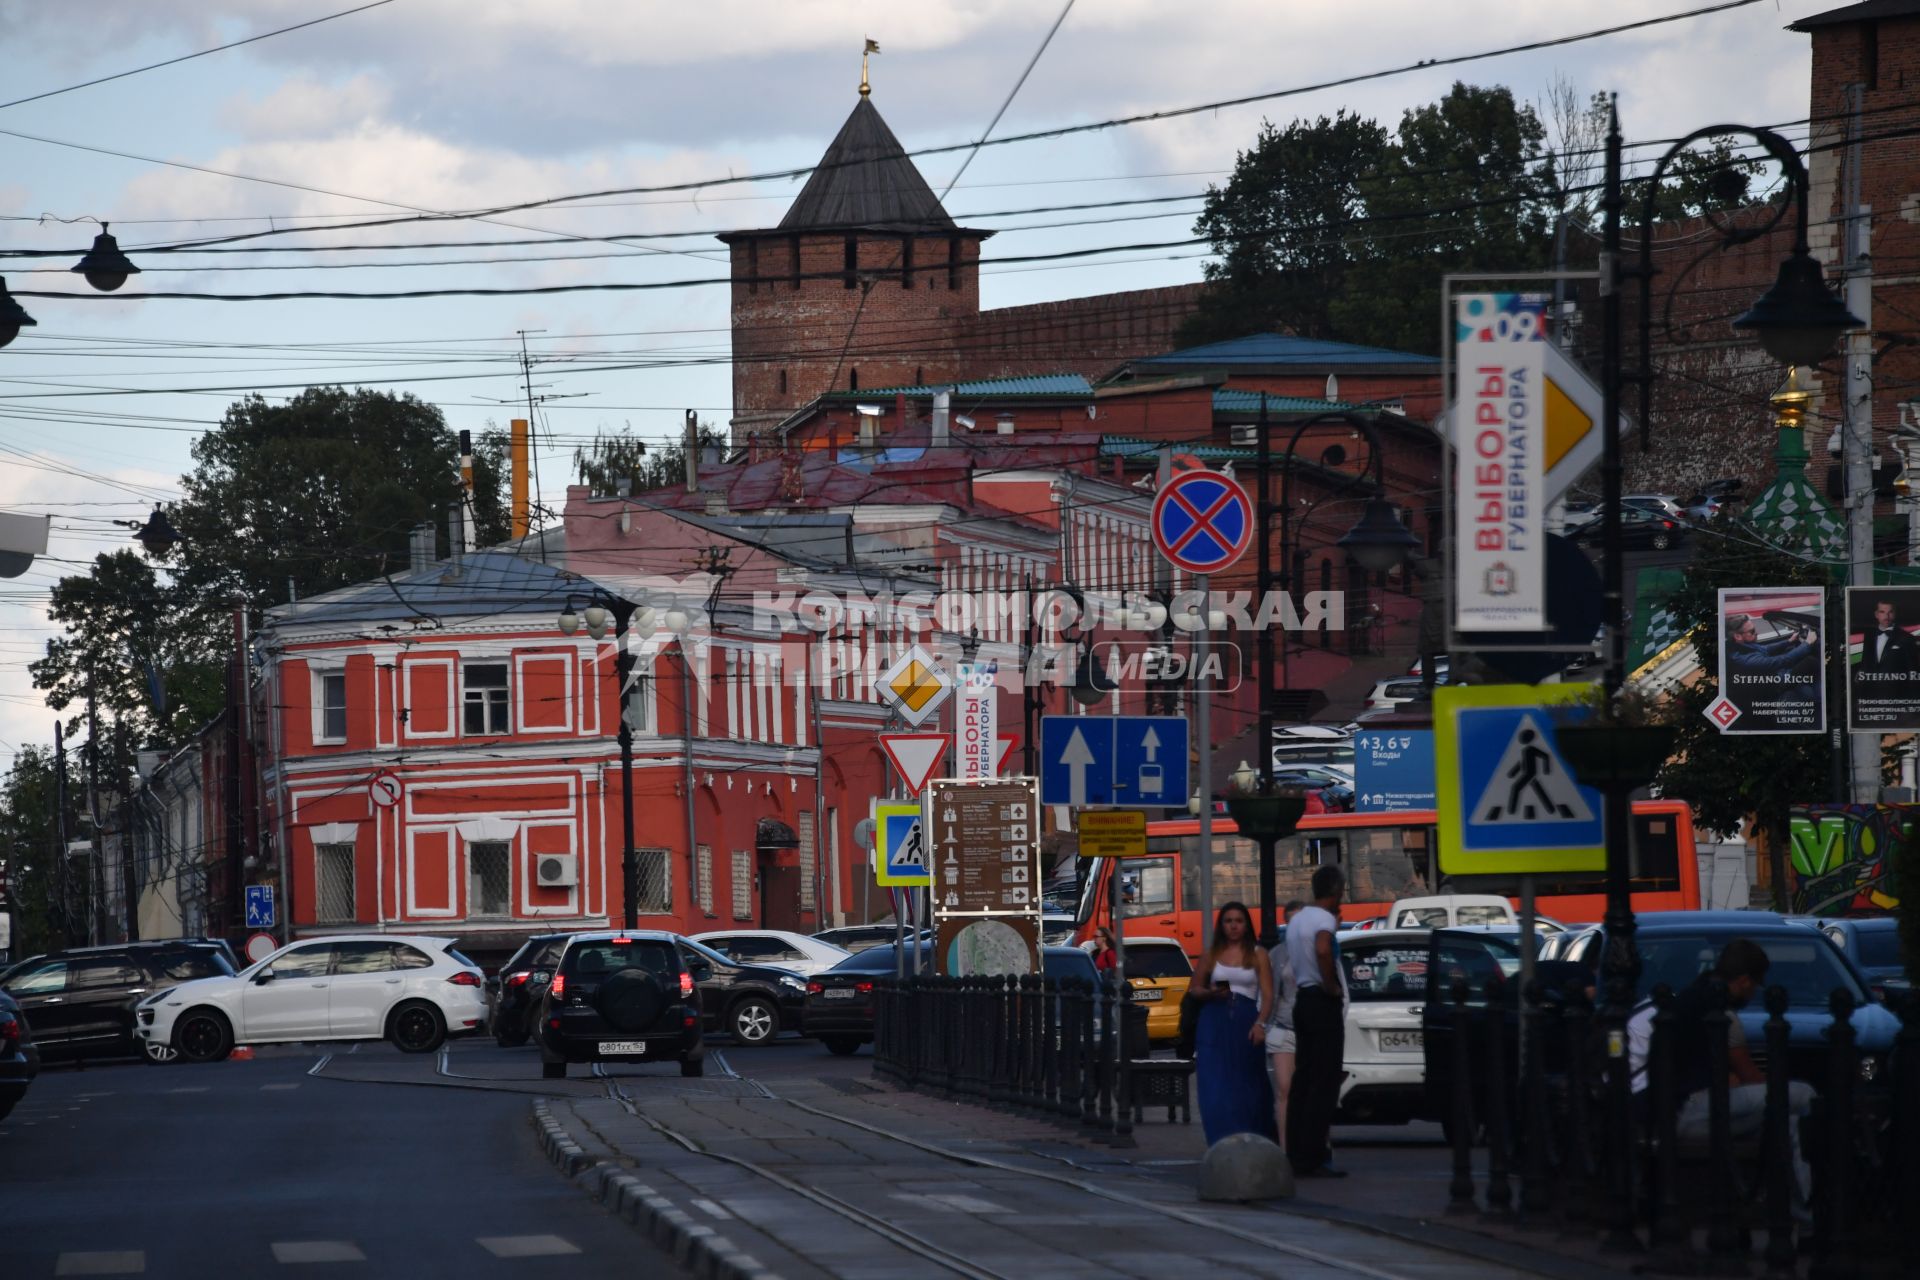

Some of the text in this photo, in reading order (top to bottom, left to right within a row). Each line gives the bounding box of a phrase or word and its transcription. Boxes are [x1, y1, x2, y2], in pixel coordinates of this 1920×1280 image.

[1498, 312, 1537, 341] 09
[1475, 367, 1505, 551] ВЫБОРЫ
[1508, 367, 1528, 551] ГУБЕРНАТОРА
[1785, 674, 1814, 684] RICCI
[1371, 737, 1397, 751] 3, 6
[1372, 751, 1400, 760] Входы
